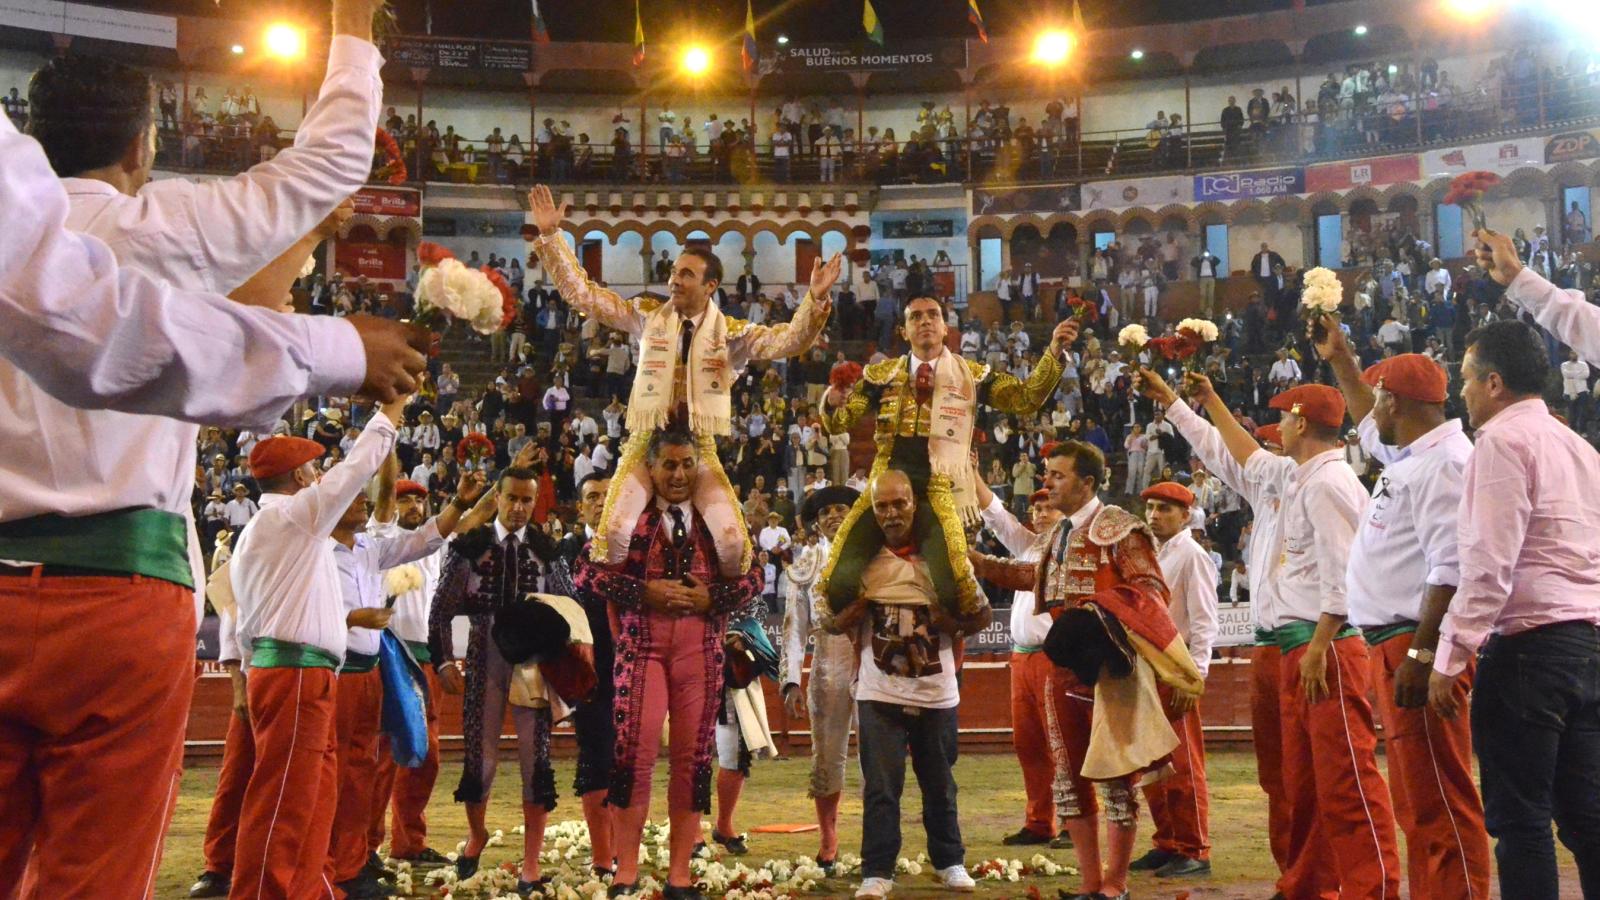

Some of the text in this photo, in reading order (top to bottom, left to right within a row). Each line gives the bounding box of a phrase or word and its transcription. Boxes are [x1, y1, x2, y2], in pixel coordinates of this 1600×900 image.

[790, 48, 831, 57] SALUD
[806, 54, 933, 67] BUENOS MOMENTOS
[1353, 168, 1369, 178] LR
[1241, 175, 1296, 188] Radio
[1272, 184, 1287, 193] AM
